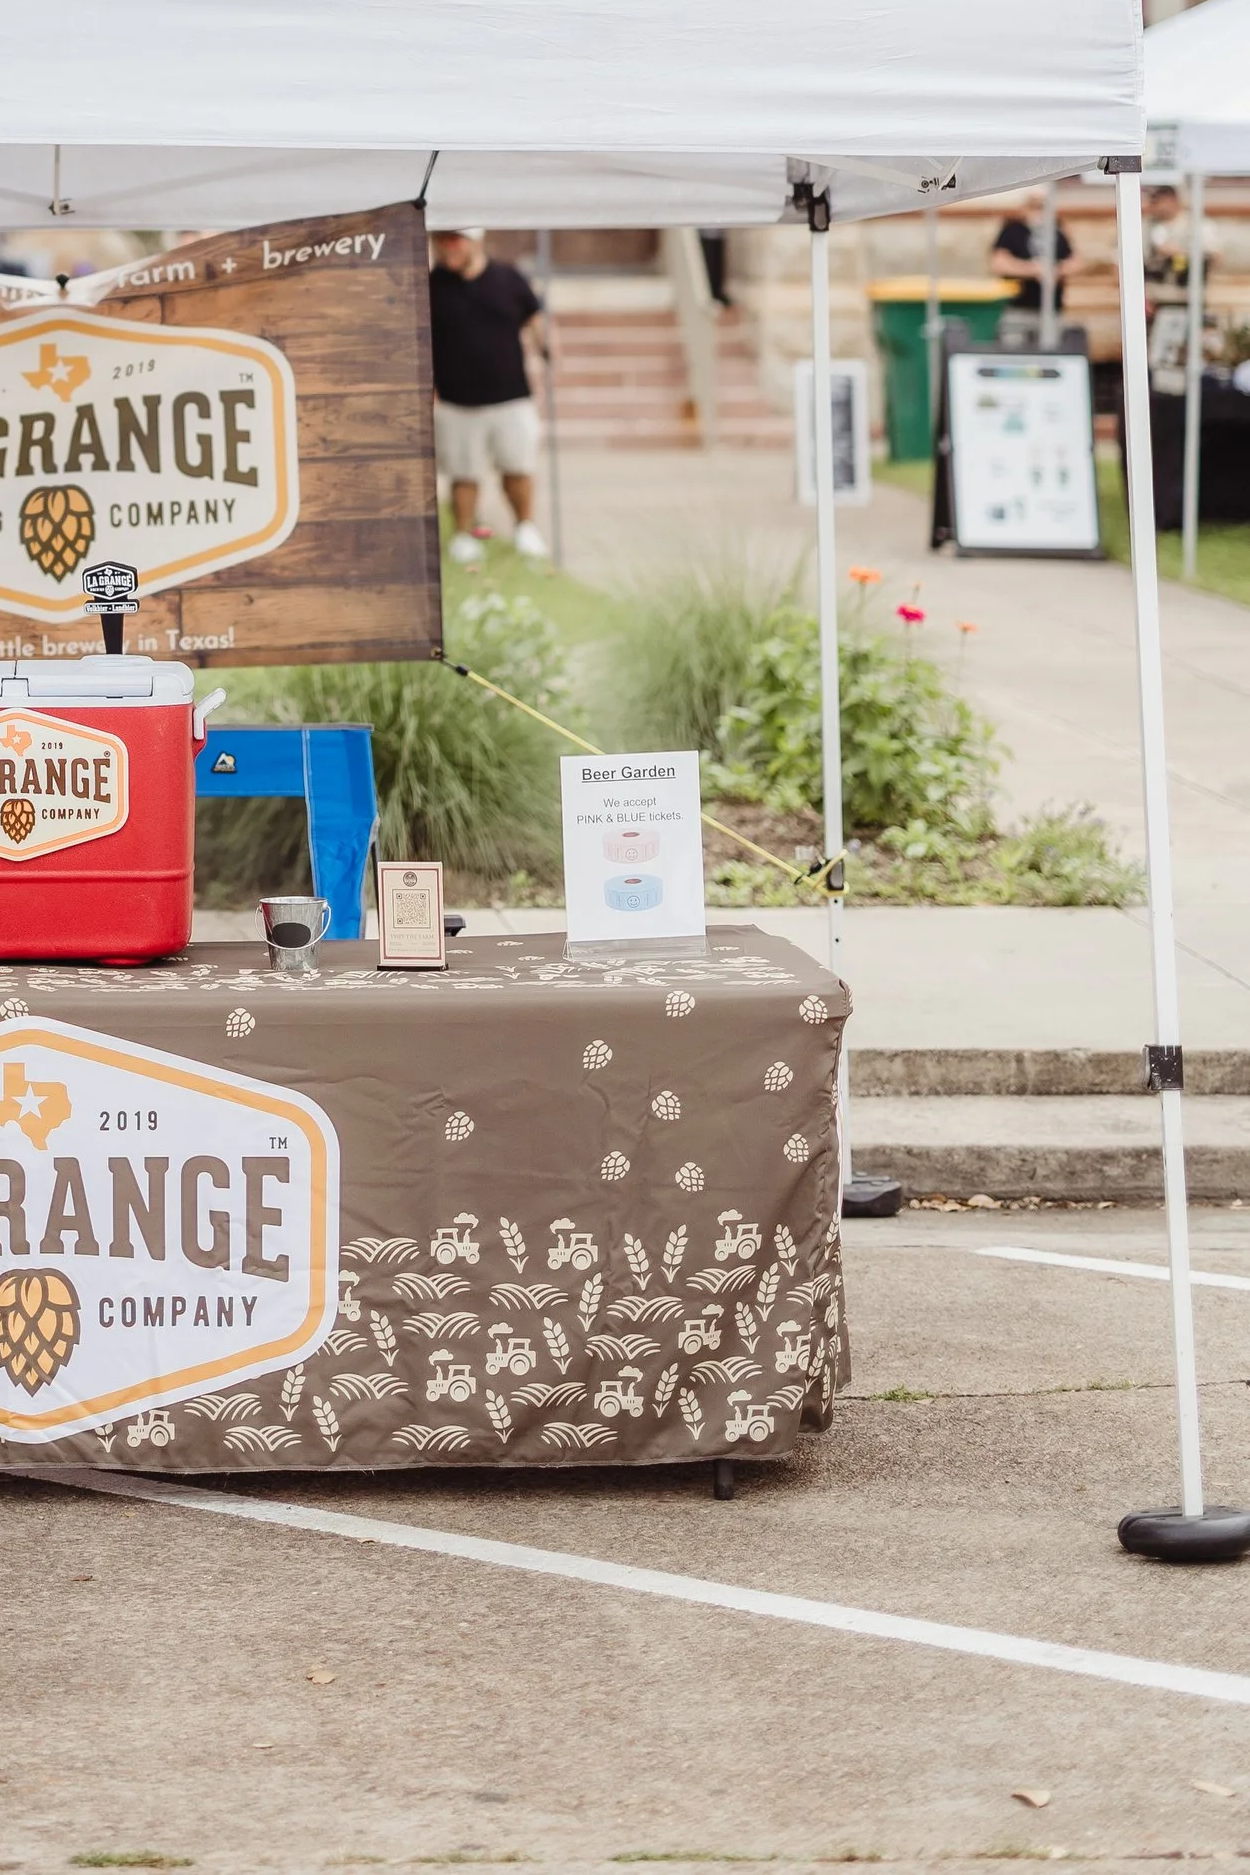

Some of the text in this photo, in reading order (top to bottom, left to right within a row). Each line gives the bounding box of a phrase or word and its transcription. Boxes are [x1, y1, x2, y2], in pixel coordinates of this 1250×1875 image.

[262, 232, 386, 270] brewery
[112, 358, 157, 380] 2019
[110, 498, 237, 528] COMPANY
[87, 575, 132, 588] LA GRANGE
[138, 633, 158, 651] in
[165, 626, 235, 651] Texas!
[41, 742, 64, 750] 2019
[582, 765, 675, 781] Beer Garden
[603, 797, 657, 808] We accept
[41, 808, 100, 820] COMPANY
[577, 811, 684, 824] PINK & BLUE tickets.
[99, 1110, 159, 1131] 2019
[269, 1136, 289, 1149] TM
[99, 1296, 259, 1329] COMPANY
